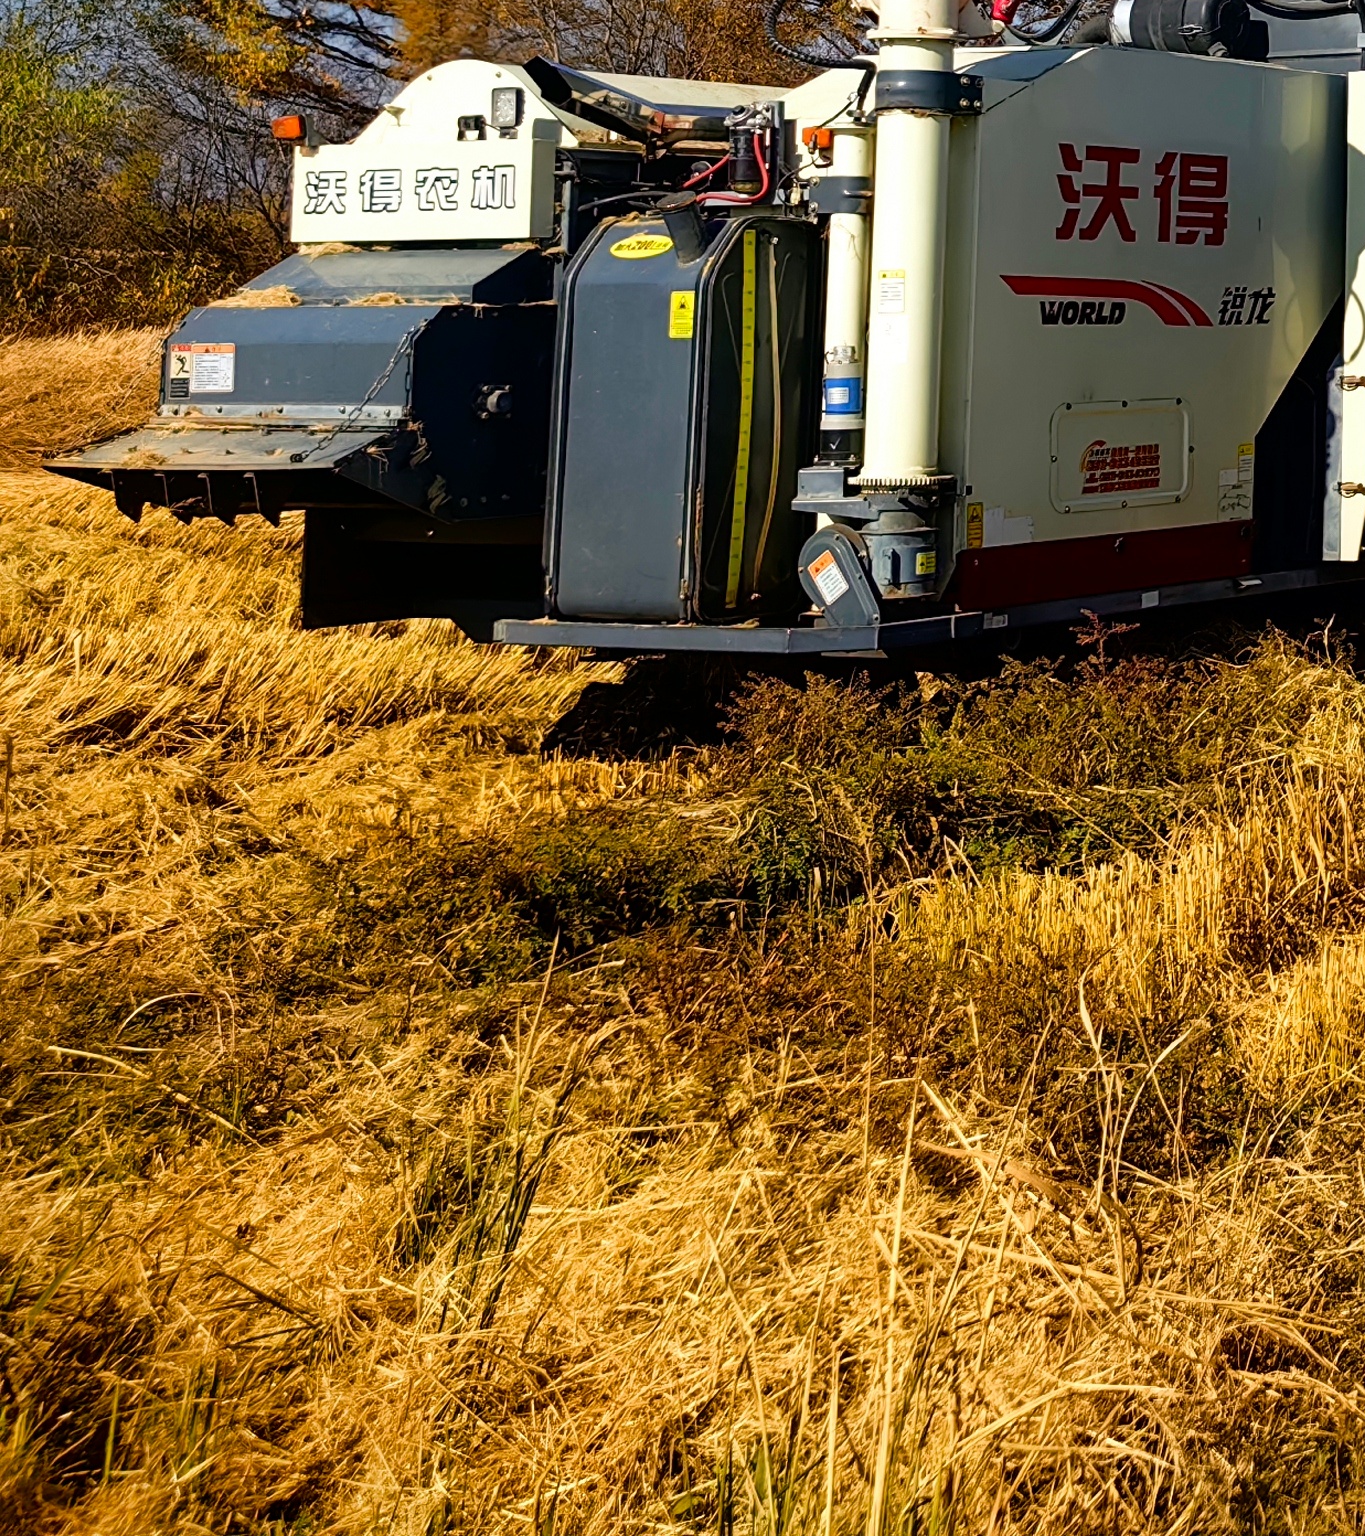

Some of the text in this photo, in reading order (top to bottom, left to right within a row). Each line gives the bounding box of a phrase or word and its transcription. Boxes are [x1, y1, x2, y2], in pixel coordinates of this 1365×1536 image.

[303, 164, 516, 214] 沃得农机
[1055, 142, 1229, 246] 沃得
[1040, 300, 1127, 326] WORLD
[1217, 286, 1277, 326] 锐龙
